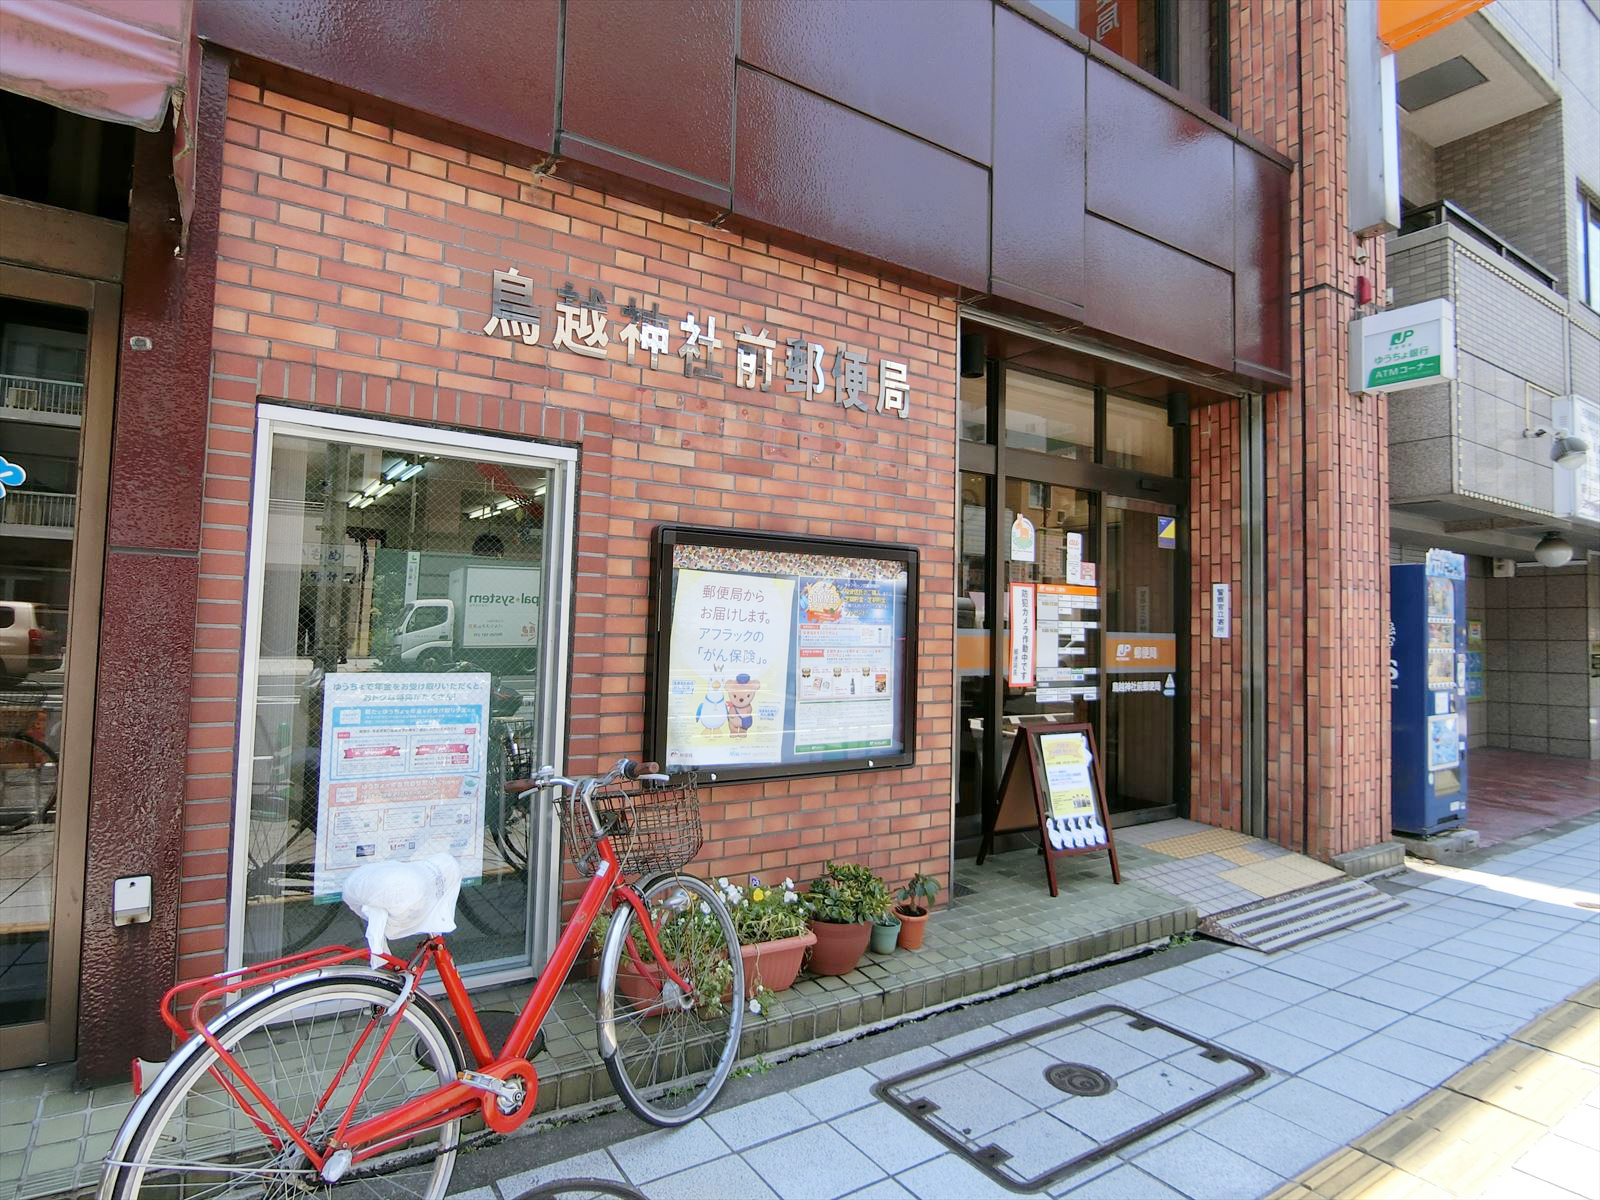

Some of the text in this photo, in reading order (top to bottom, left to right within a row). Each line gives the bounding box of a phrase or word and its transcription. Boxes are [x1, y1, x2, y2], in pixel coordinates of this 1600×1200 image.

[483, 267, 910, 419] 鳥越神社前郵便局
[1391, 330, 1414, 345] JP
[1375, 345, 1429, 364] ゆうちょ銀行
[1376, 362, 1435, 378] ATMコーナー
[702, 584, 765, 603] 郵便局から
[700, 606, 770, 625] お届けします。
[698, 627, 764, 643] アフラックの
[1021, 588, 1029, 680] 防犯カメラ作動中です
